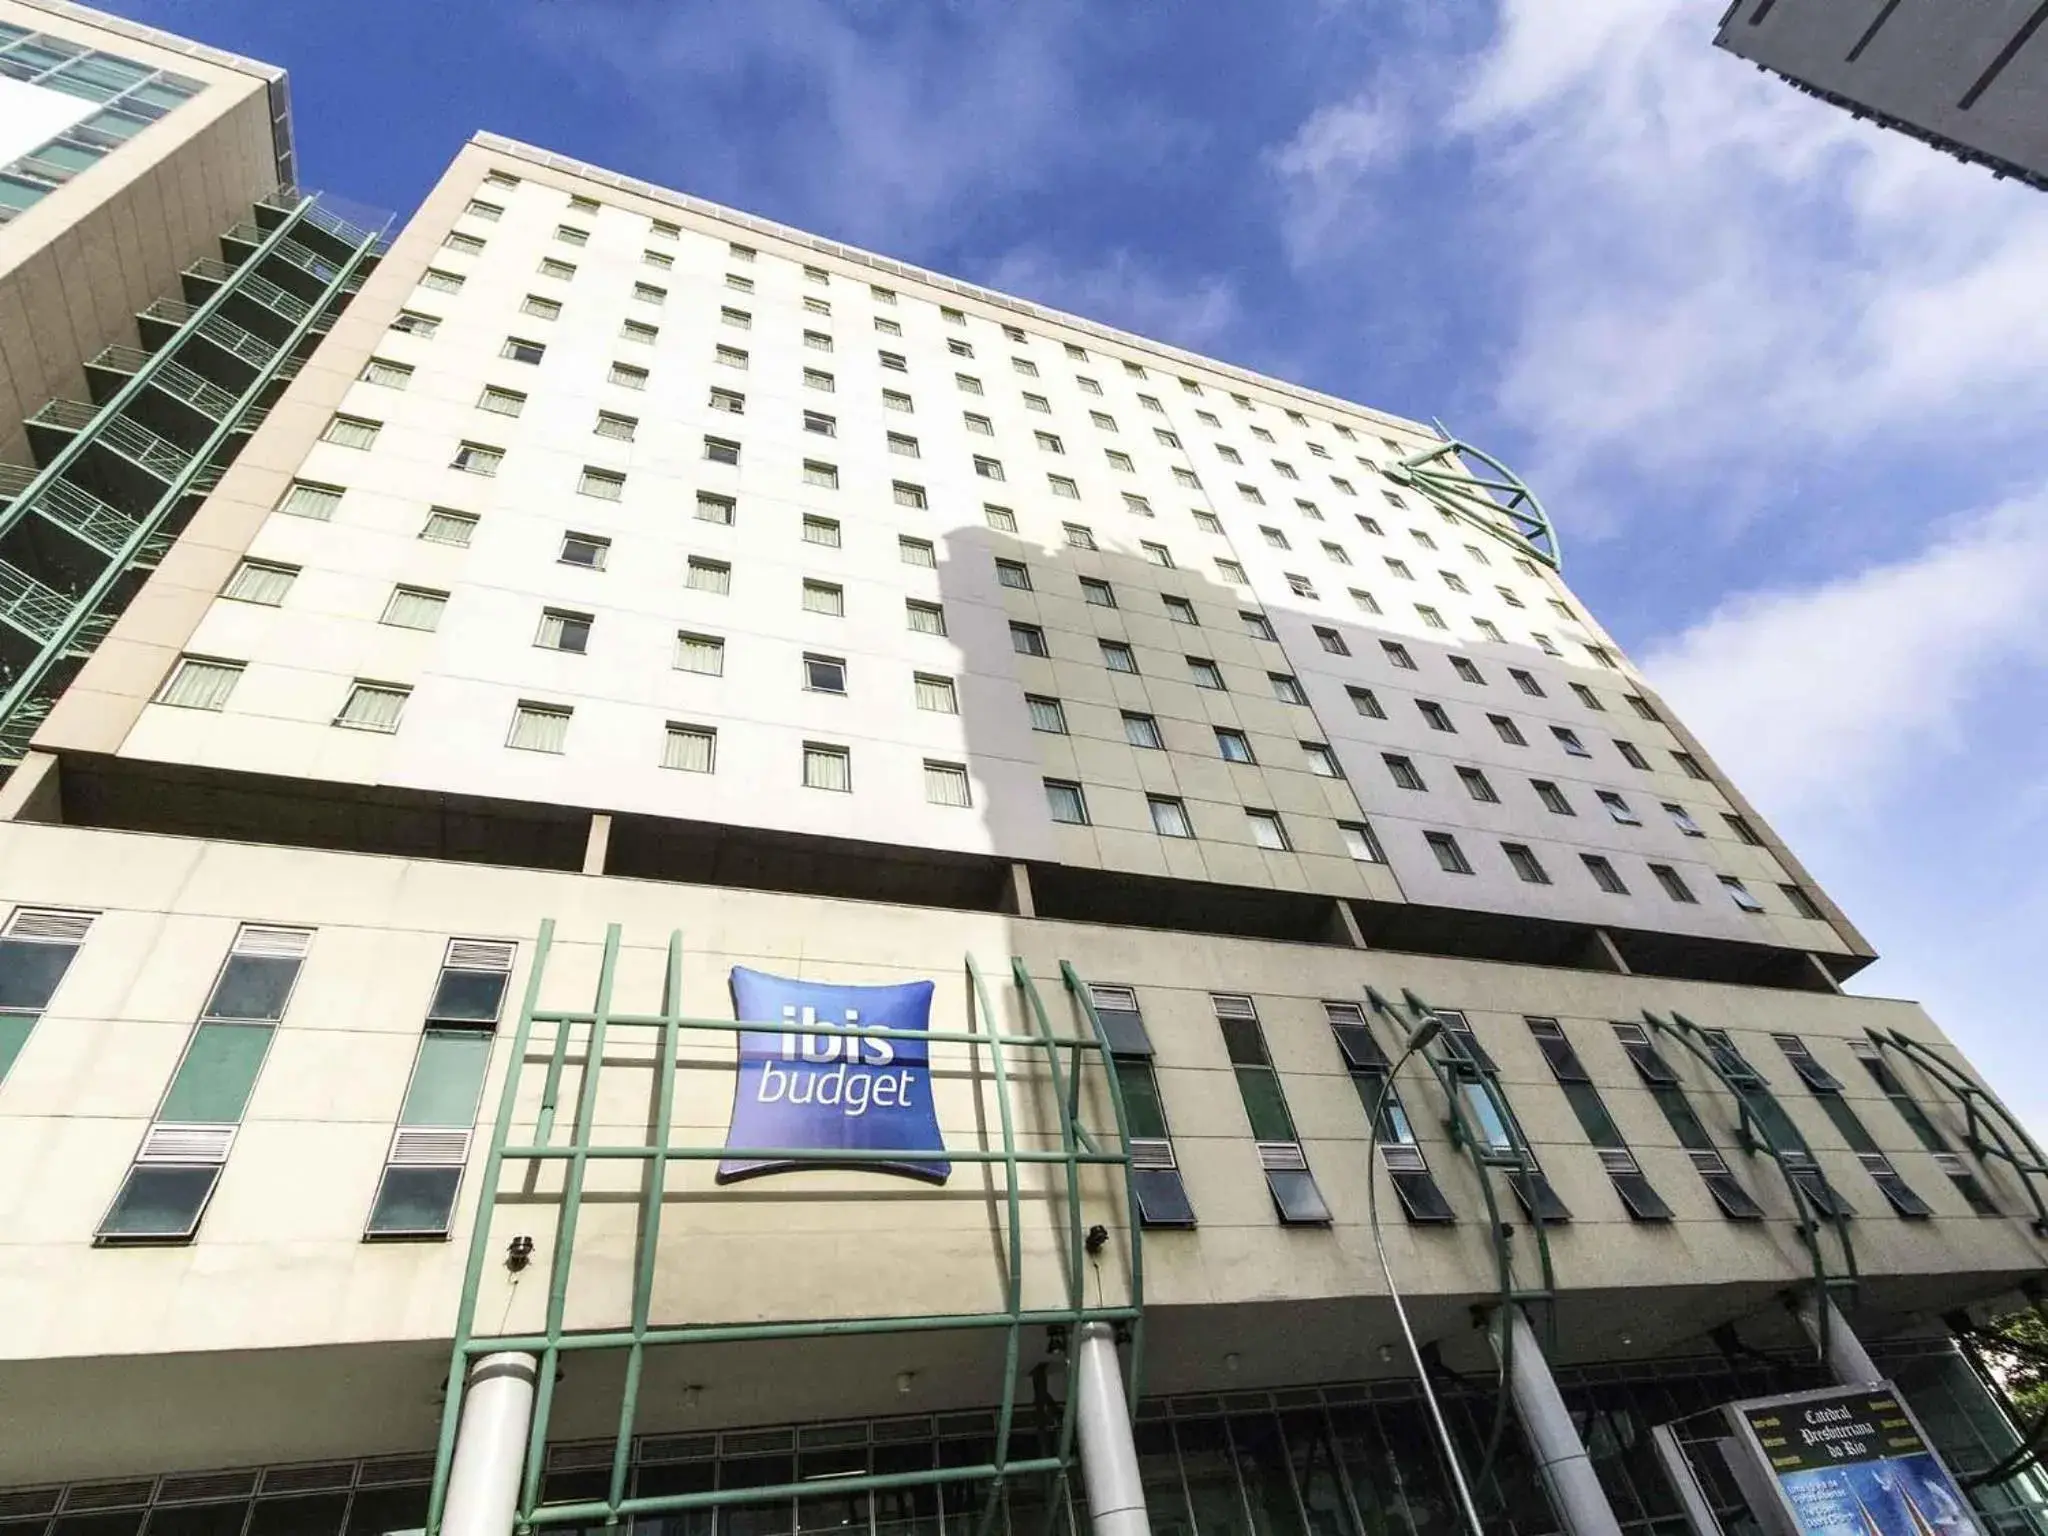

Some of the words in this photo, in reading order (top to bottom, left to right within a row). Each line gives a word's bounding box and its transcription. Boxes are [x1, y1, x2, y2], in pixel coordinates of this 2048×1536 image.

[782, 1005, 894, 1065] ibis
[757, 1061, 915, 1116] budget
[1805, 1405, 1852, 1424] Catedral
[1827, 1444, 1843, 1457] do
[1845, 1440, 1867, 1456] Rio
